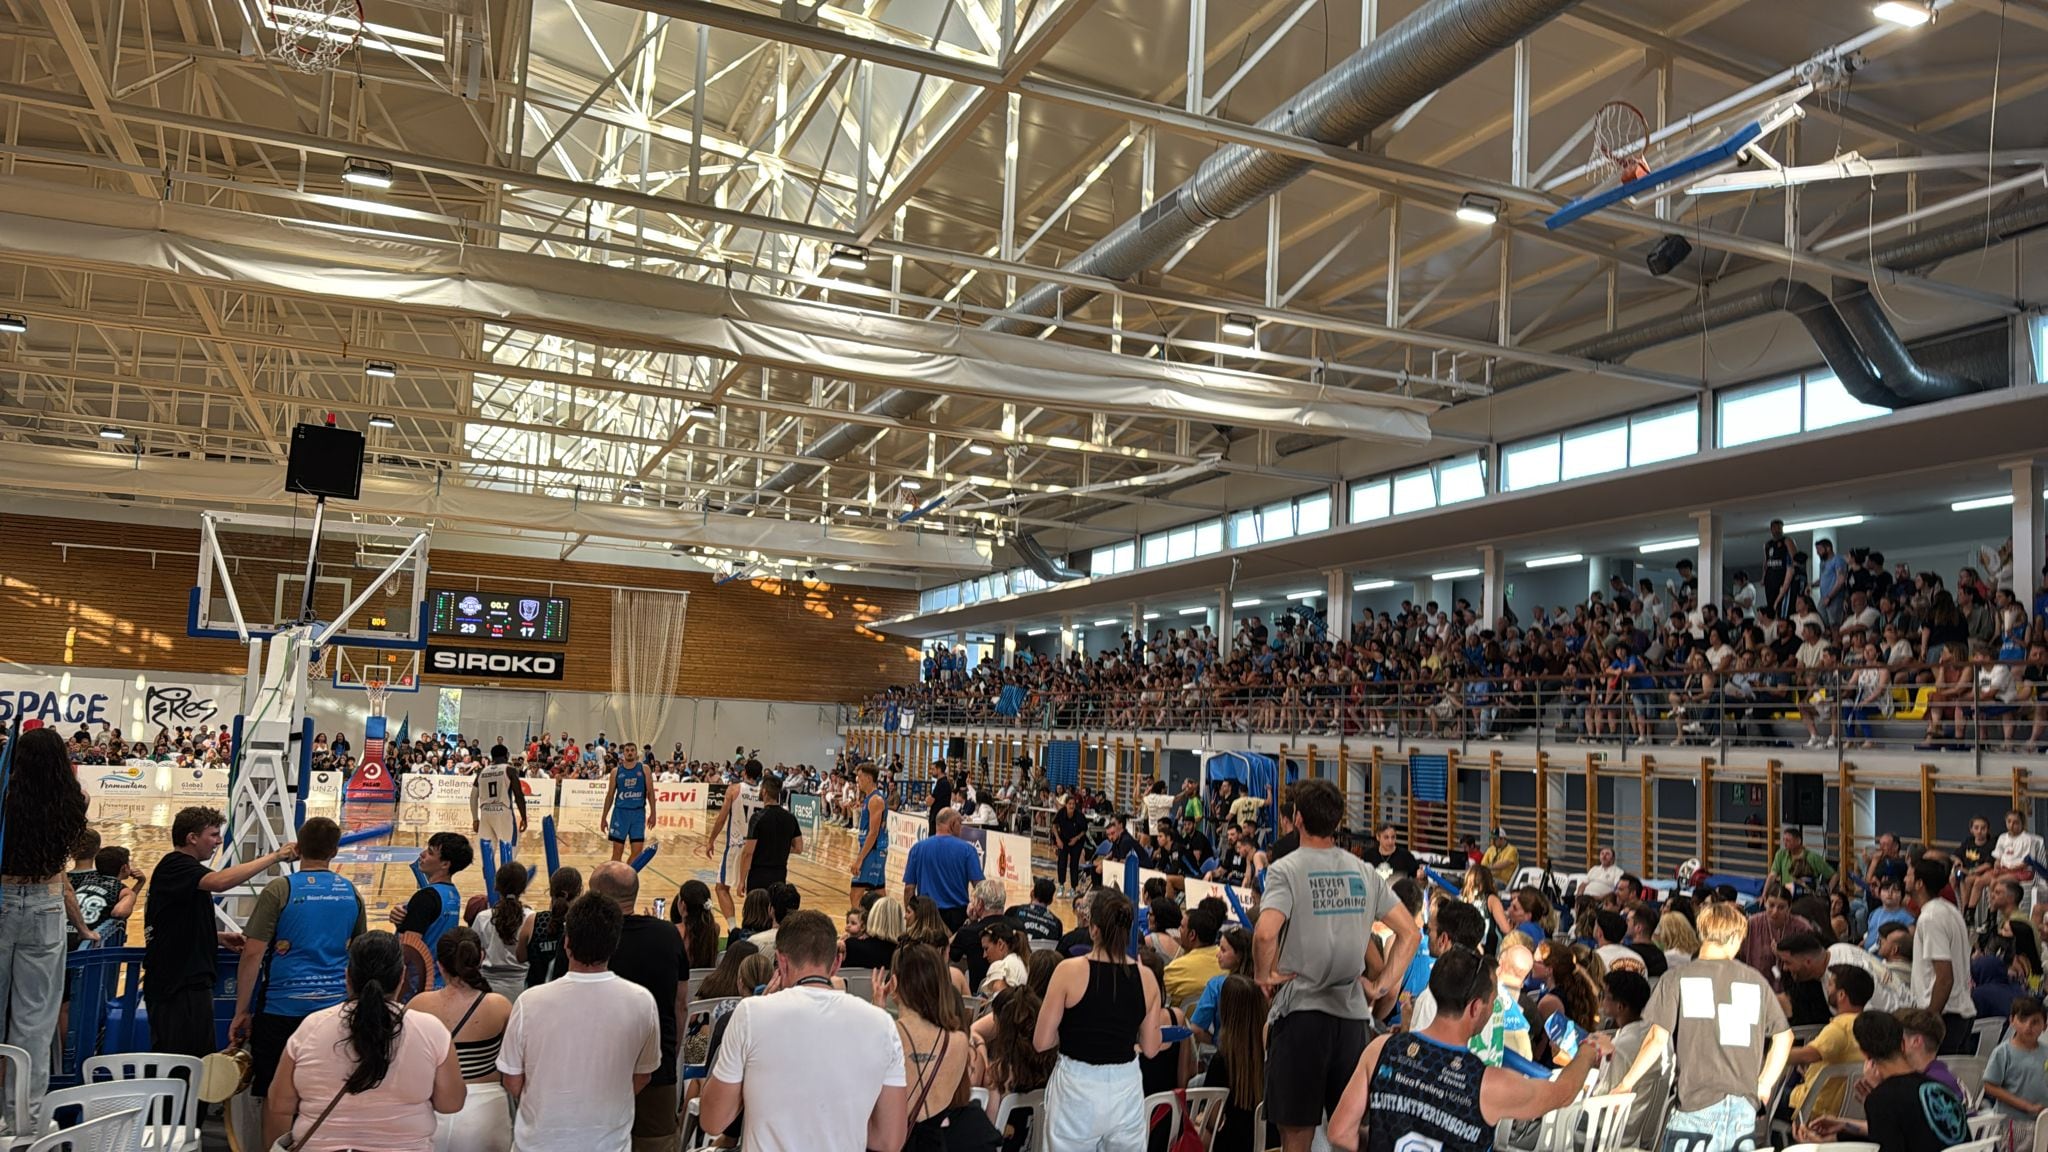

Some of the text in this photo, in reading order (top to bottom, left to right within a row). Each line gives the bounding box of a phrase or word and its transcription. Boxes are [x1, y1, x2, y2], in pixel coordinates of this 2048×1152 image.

[460, 623, 477, 633] 29
[520, 627, 535, 637] 17
[434, 651, 555, 674] SIROKO
[488, 782, 497, 798] 0
[1309, 877, 1345, 889] NEVER
[1312, 888, 1340, 899] STOP
[1313, 897, 1366, 909] EXPLORING
[1024, 921, 1049, 936] SOLER
